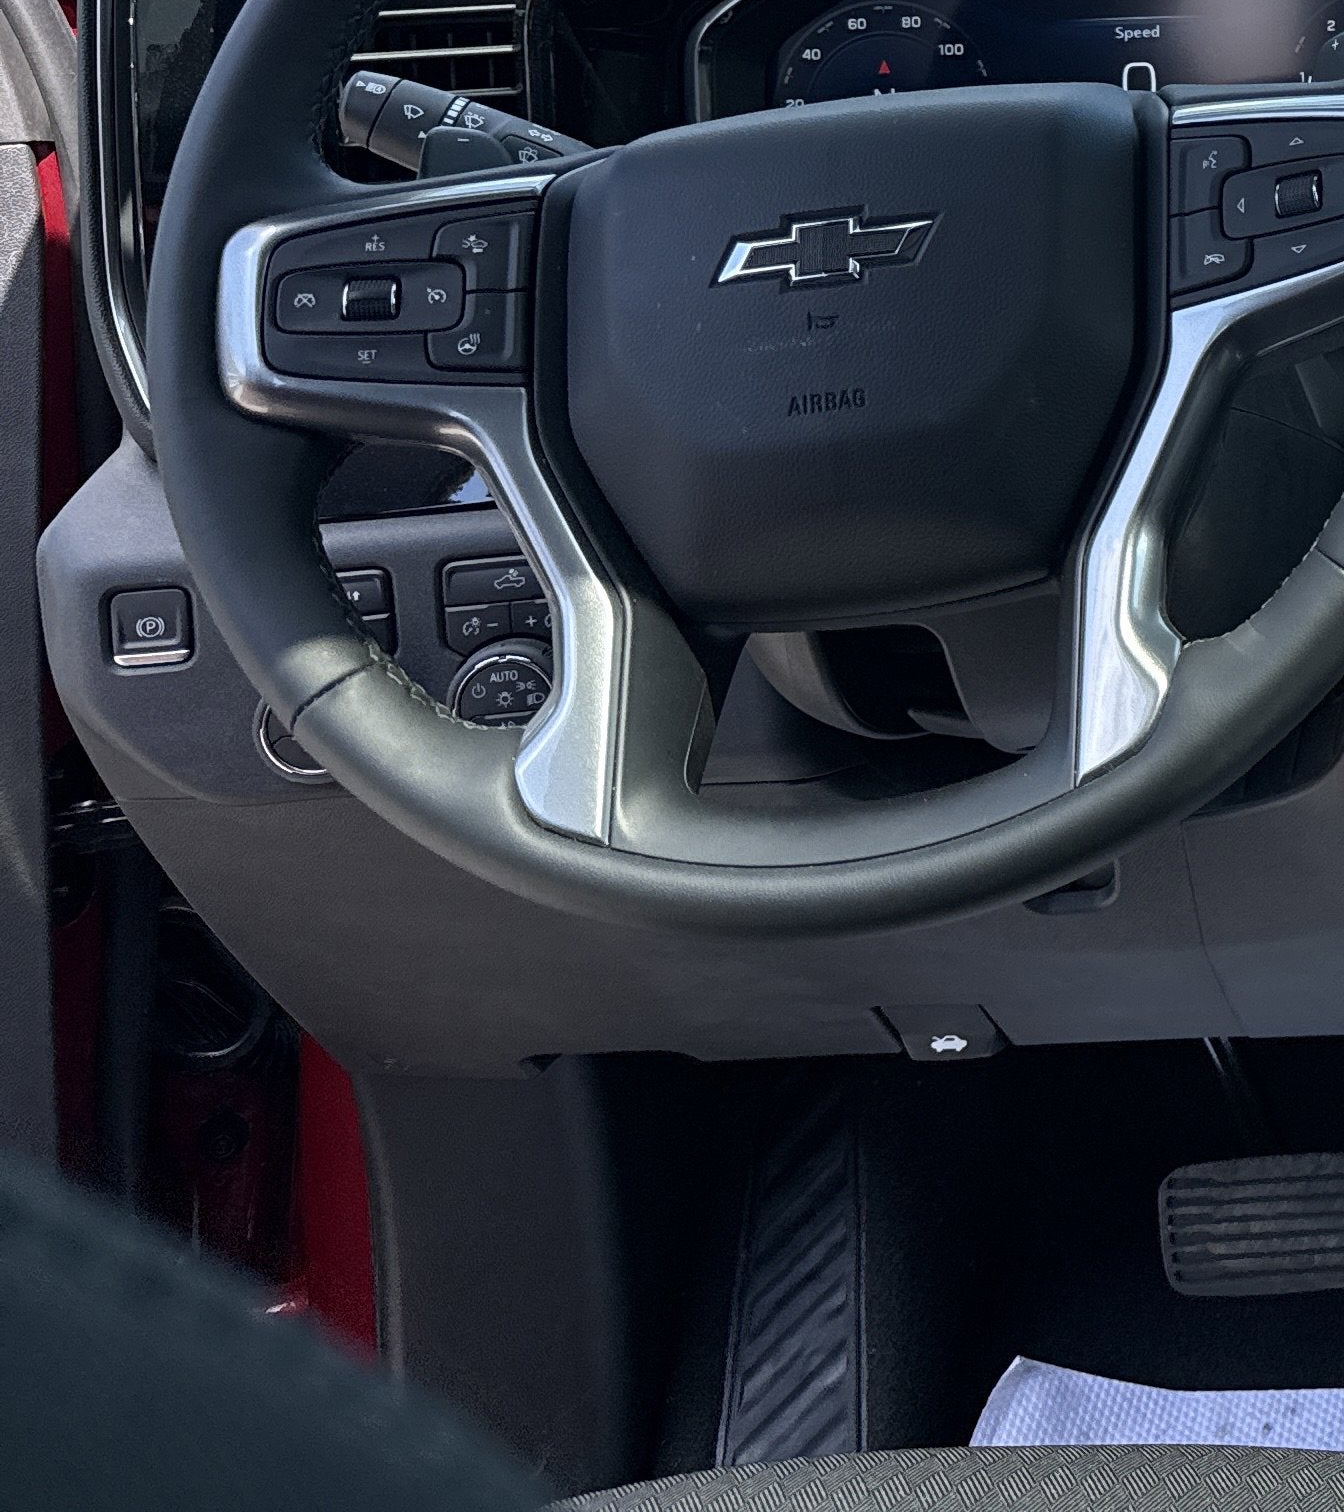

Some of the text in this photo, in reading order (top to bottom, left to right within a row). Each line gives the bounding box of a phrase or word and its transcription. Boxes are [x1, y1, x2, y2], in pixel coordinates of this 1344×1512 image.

[847, 17, 867, 30] 60
[901, 16, 922, 29] 80
[1327, 20, 1336, 32] 2
[1115, 25, 1160, 42] Speed
[802, 48, 821, 61] 40
[938, 44, 965, 56] 100
[364, 241, 386, 252] RES
[357, 349, 378, 361] SET
[788, 386, 867, 417] AIRBAG
[490, 670, 519, 683] AUTO
